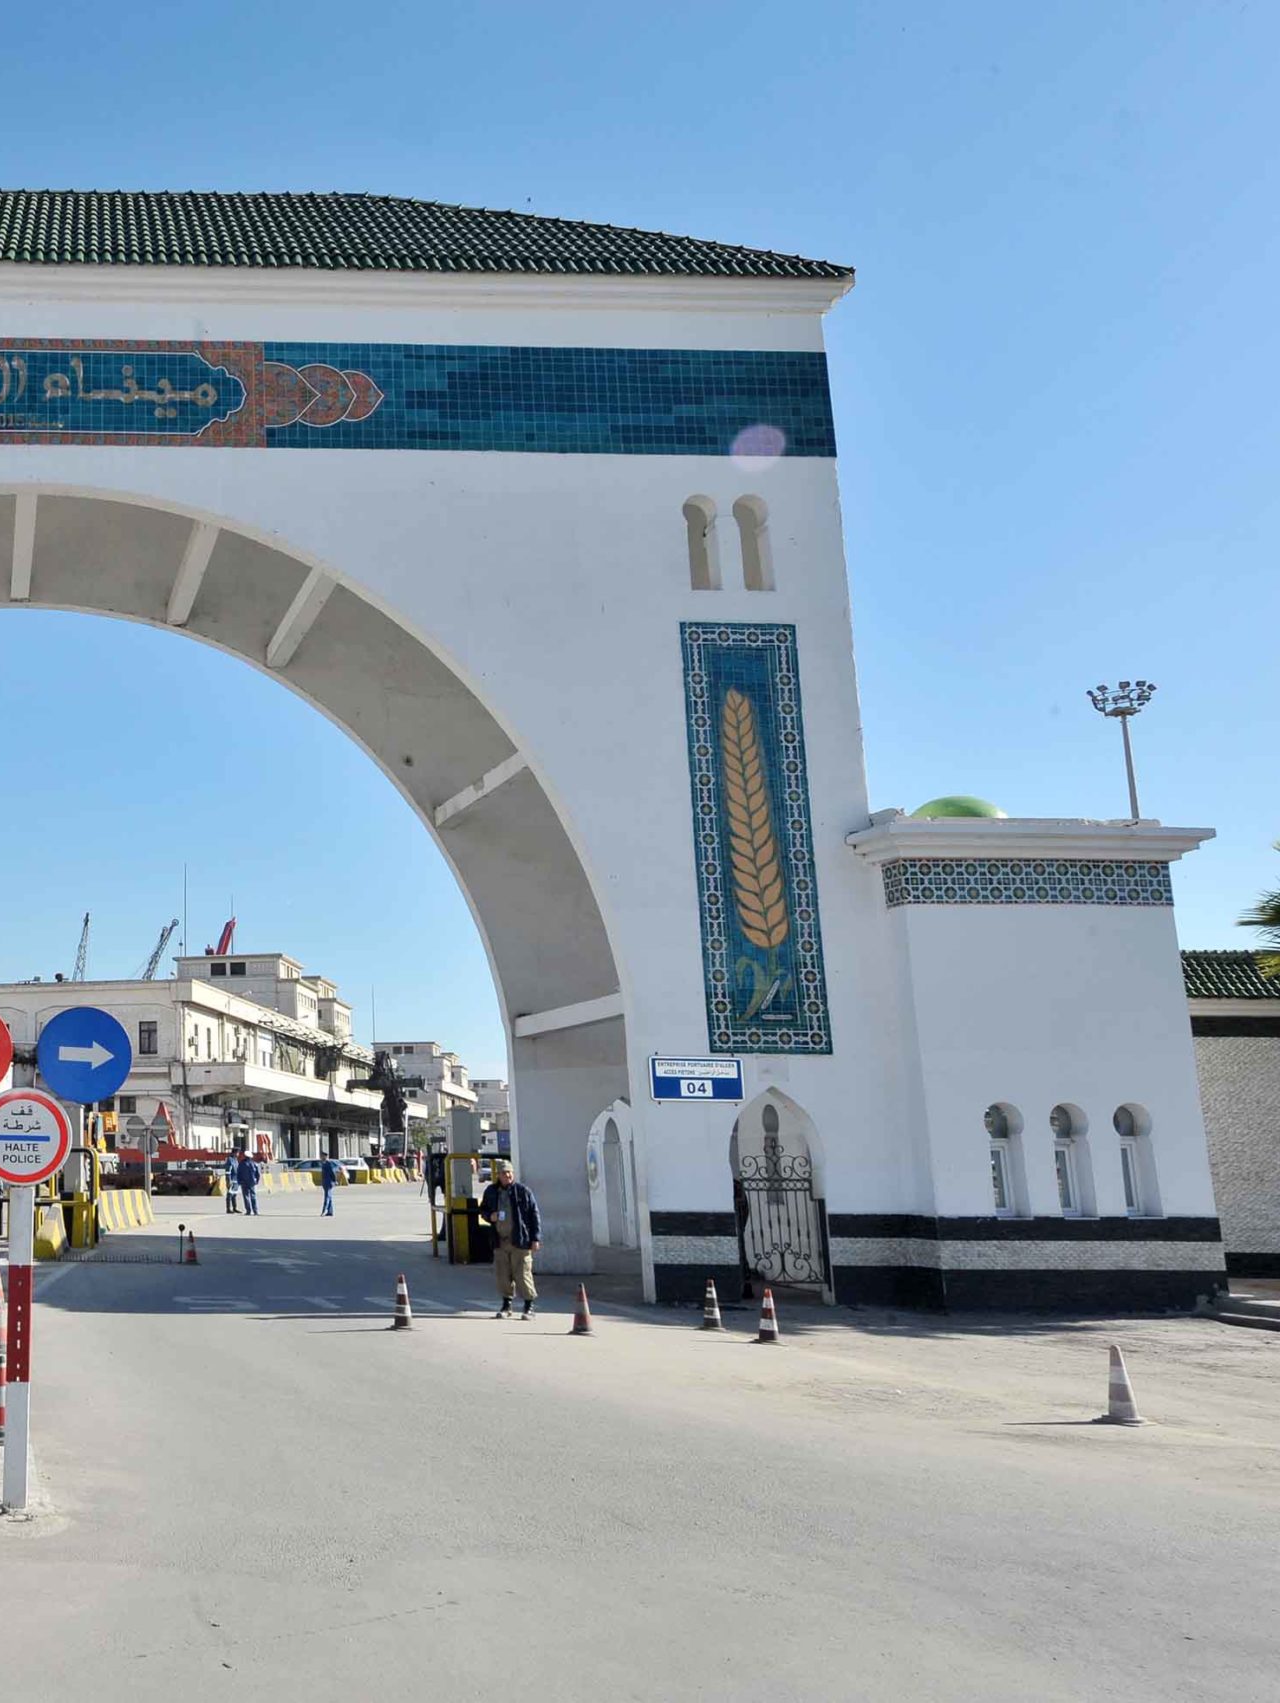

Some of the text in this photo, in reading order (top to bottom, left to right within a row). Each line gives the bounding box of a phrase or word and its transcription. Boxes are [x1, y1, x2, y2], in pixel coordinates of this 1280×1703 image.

[43, 357, 218, 419] ميناء
[687, 1082, 708, 1094] 04
[3, 1118, 41, 1133] شرطة
[5, 1143, 39, 1152] HALTE
[2, 1154, 41, 1164] POLICE
